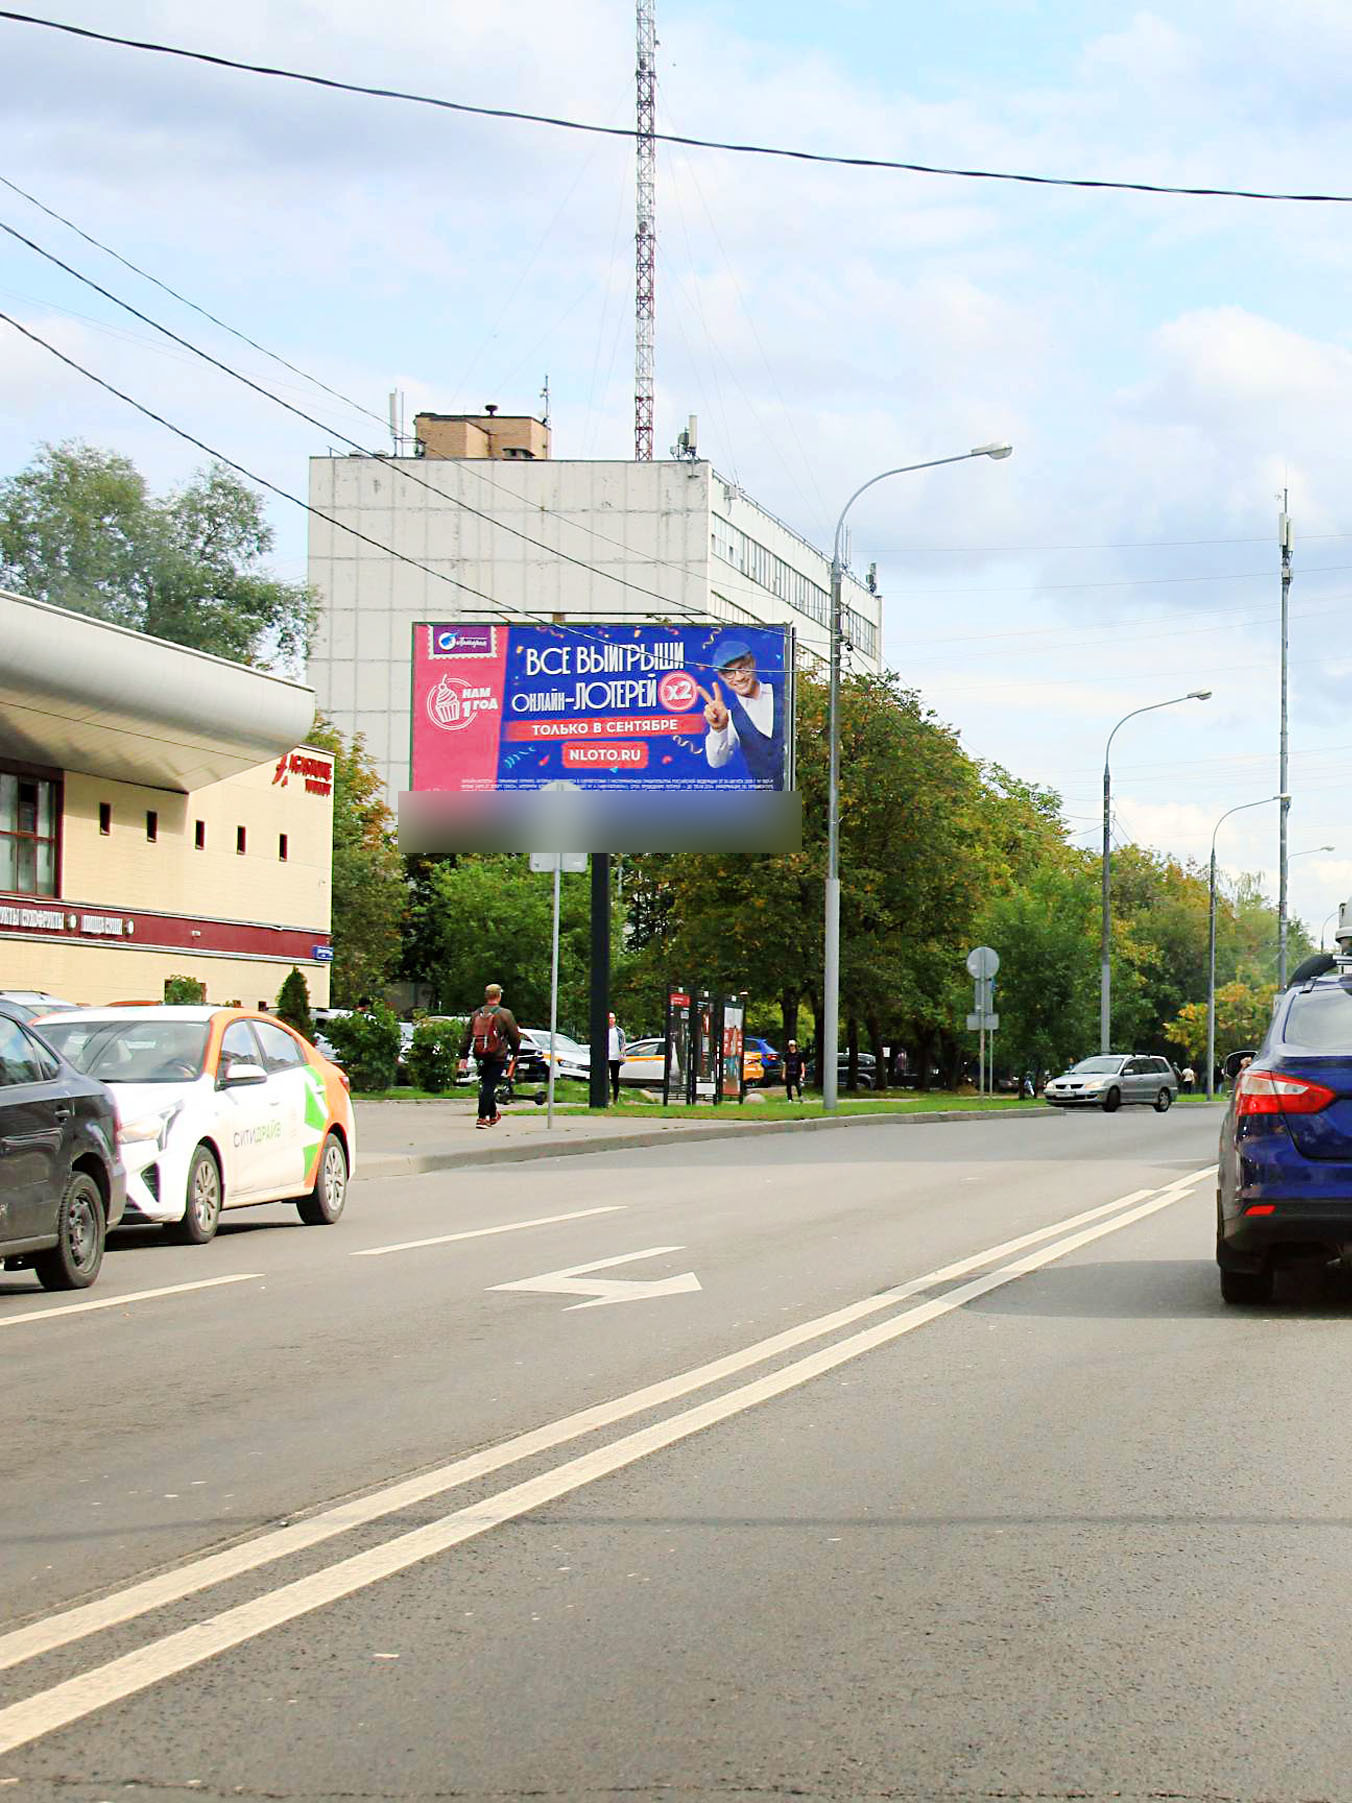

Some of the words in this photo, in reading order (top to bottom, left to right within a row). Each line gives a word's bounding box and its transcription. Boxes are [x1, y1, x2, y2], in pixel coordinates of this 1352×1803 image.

[526, 647, 571, 676] ВСЕ
[577, 642, 685, 674] ВЫИГРЫШИ
[462, 687, 491, 698] НАМ
[512, 673, 656, 712] ОНЛАЙН-ЛОТЕРЕЙ
[462, 701, 471, 718] 1
[472, 698, 498, 710] ГОД
[532, 723, 589, 735] ТОЛЬКО
[593, 721, 602, 733] В
[606, 719, 679, 733] СЕНТЯБРЕ
[569, 749, 641, 761] NLOTO.RU
